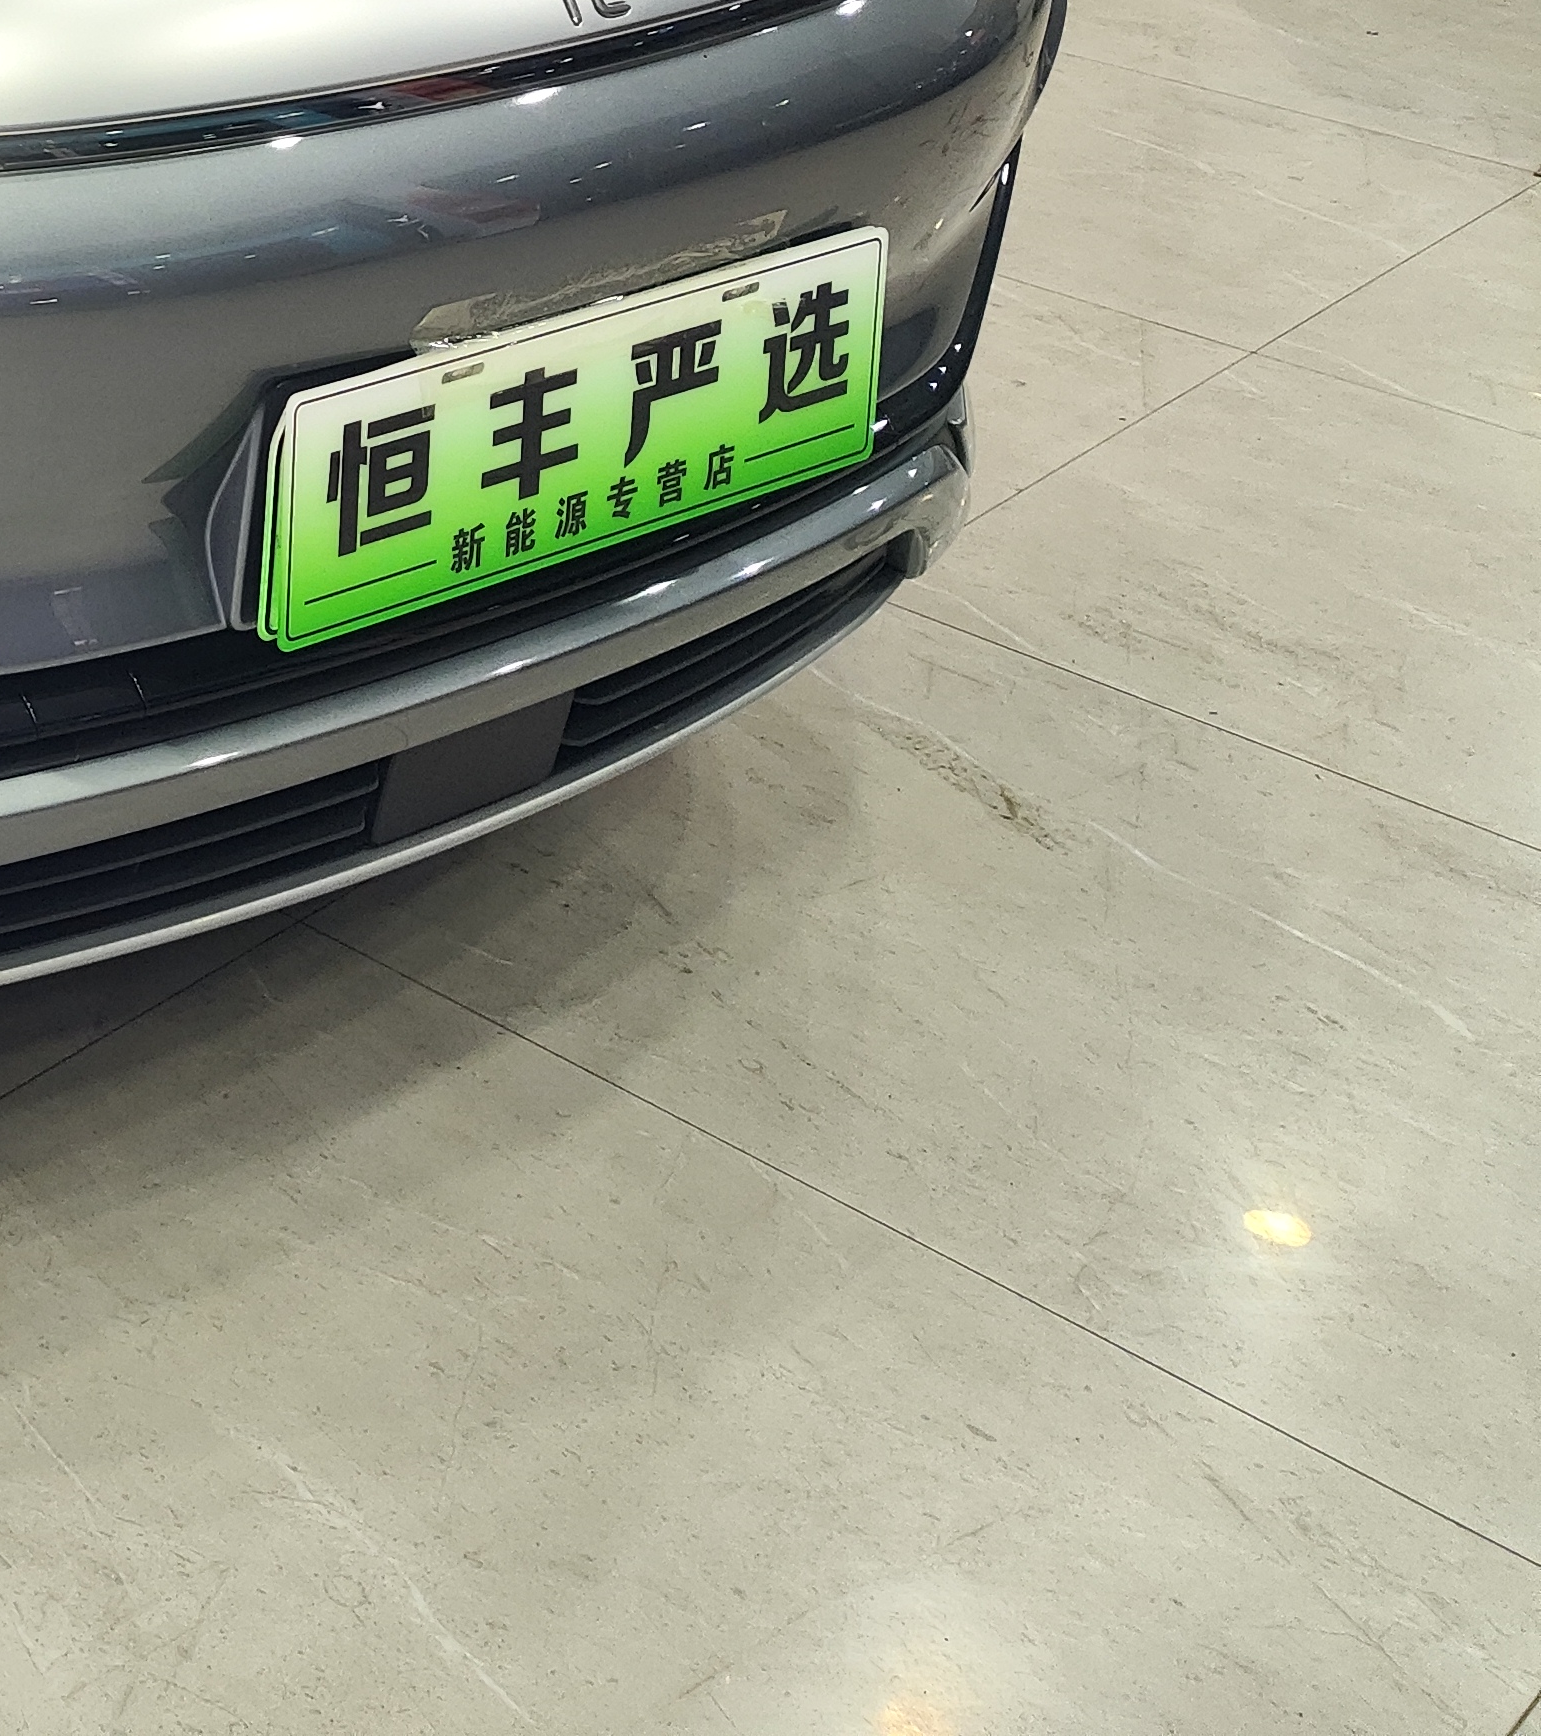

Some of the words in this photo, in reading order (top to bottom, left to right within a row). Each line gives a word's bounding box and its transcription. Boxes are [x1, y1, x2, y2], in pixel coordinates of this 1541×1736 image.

[326, 281, 850, 557] 恒丰严选
[450, 444, 735, 575] 新能源专营店
